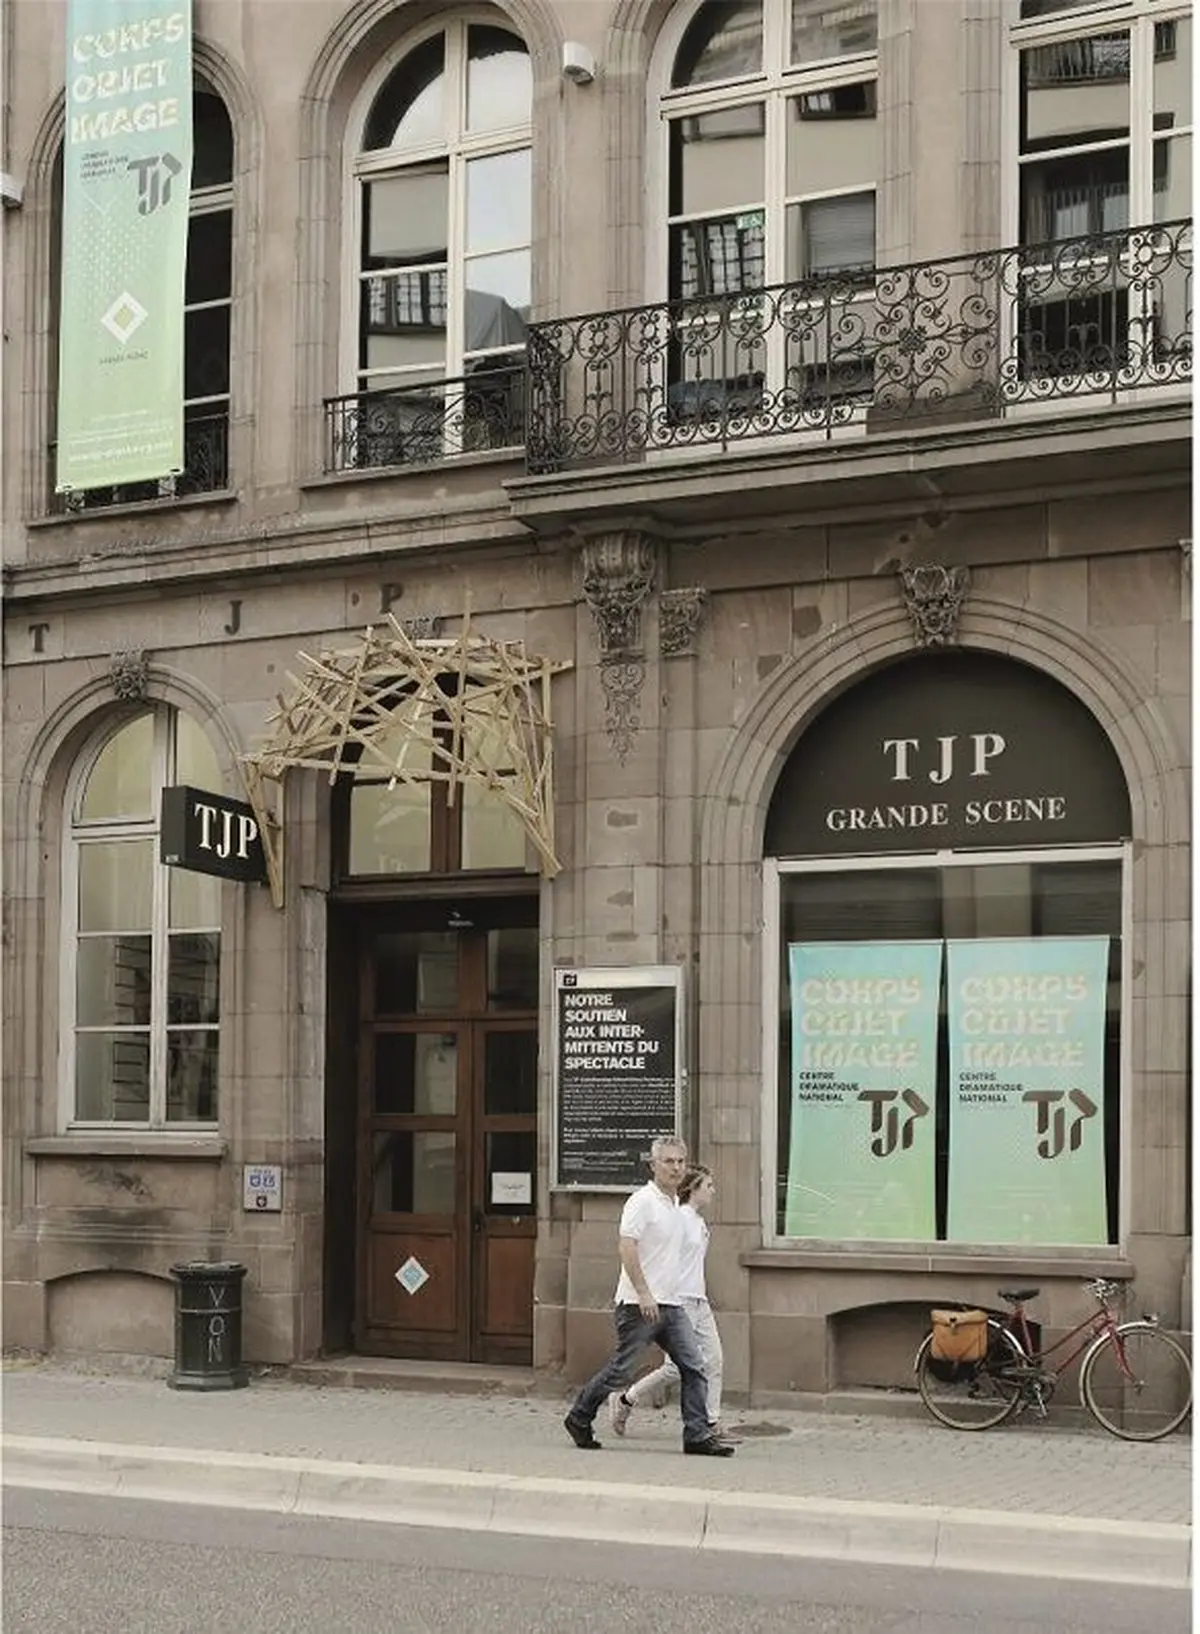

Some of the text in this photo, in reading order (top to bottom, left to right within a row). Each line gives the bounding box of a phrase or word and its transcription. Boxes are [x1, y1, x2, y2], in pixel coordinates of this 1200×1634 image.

[71, 97, 180, 144] IMAGE
[826, 797, 1066, 831] GRANDE SCENE
[194, 803, 259, 859] TJP
[565, 994, 613, 1006] NOTRE
[565, 1009, 627, 1022] SOUTIEN
[565, 1025, 645, 1038] AUX INTER-
[565, 1041, 659, 1054] MITTENTS DU
[802, 1041, 919, 1068] IMAGE
[962, 1041, 1084, 1067] IMAGE
[565, 1057, 645, 1069] SPECTACLE
[799, 1072, 835, 1080] CENTRE
[960, 1072, 997, 1081] CENTRE
[799, 1082, 859, 1091] DRAMATIQUE
[960, 1083, 1023, 1092] DRAMATIQUE
[799, 1093, 844, 1101] NATIONAL
[960, 1094, 1007, 1102] NATIONAL
